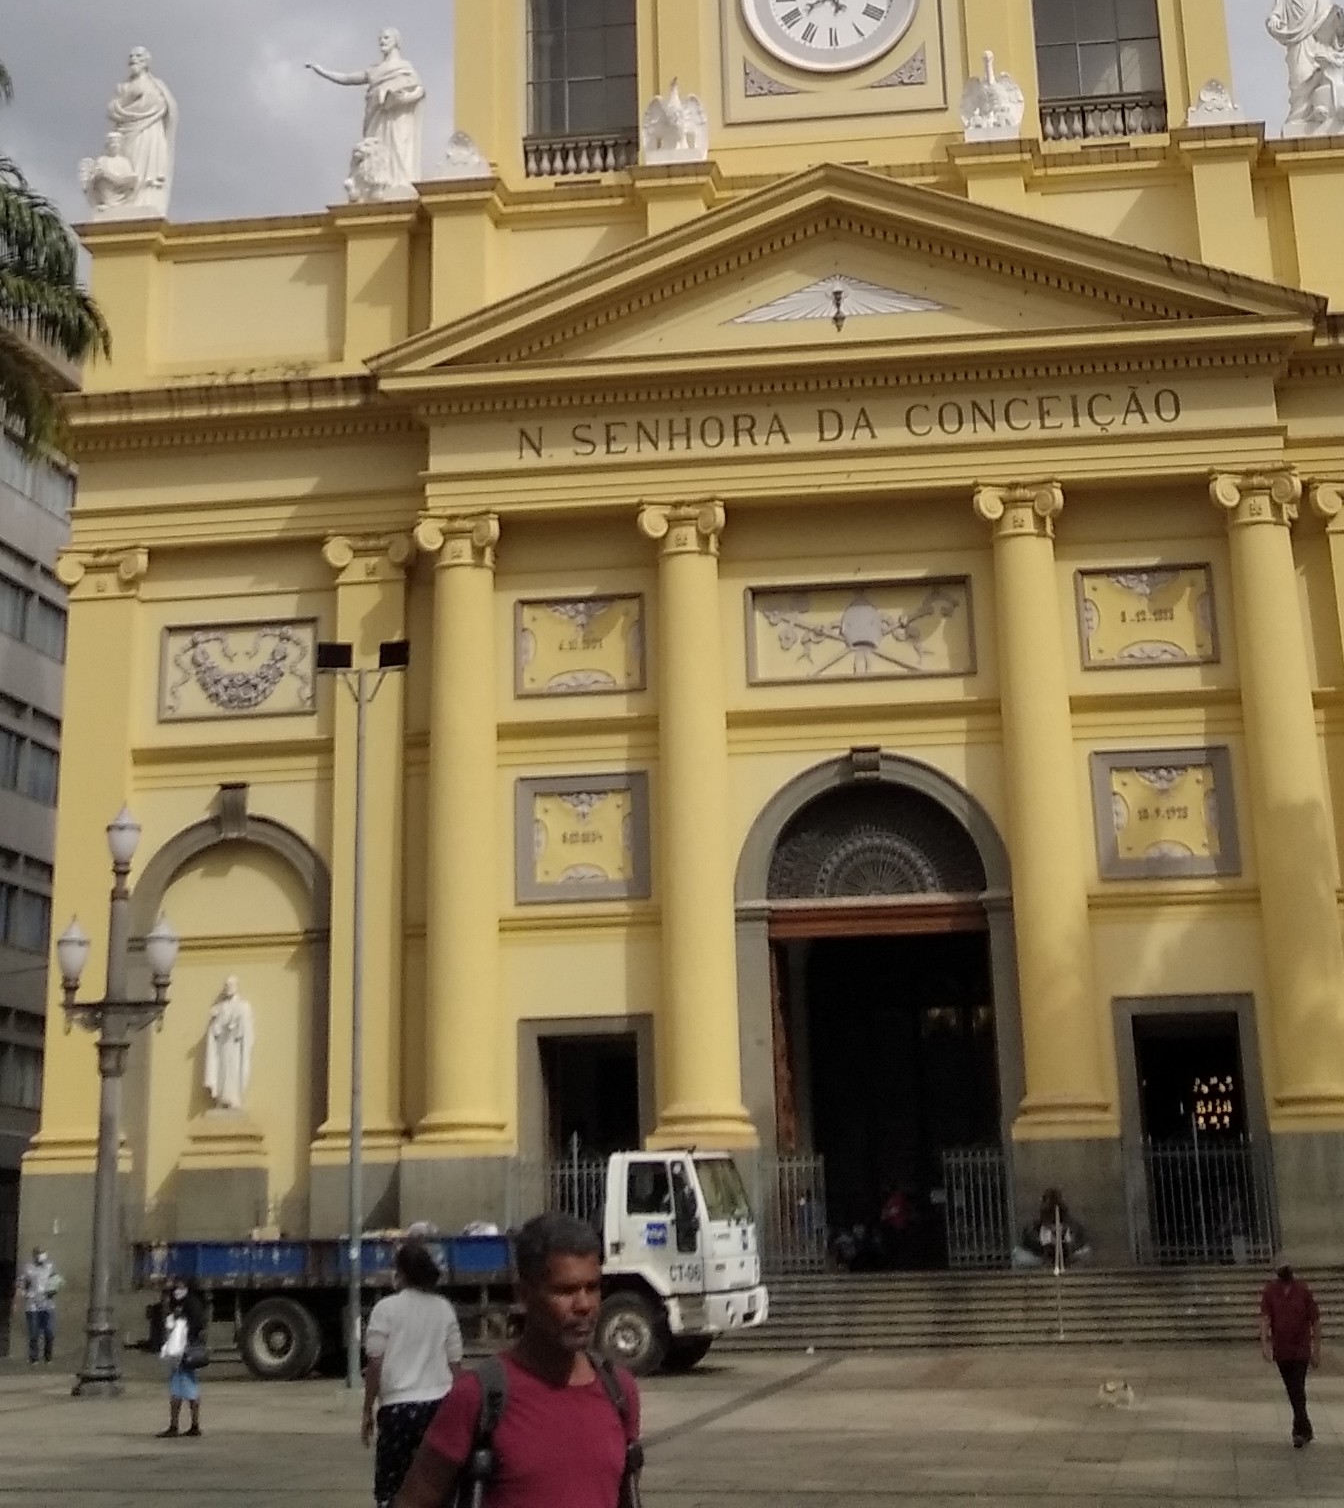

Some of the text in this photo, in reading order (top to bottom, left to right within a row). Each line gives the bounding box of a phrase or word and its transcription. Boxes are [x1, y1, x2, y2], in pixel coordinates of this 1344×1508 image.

[518, 385, 1181, 460] N. SENHORA DA CONCEIÇÃO
